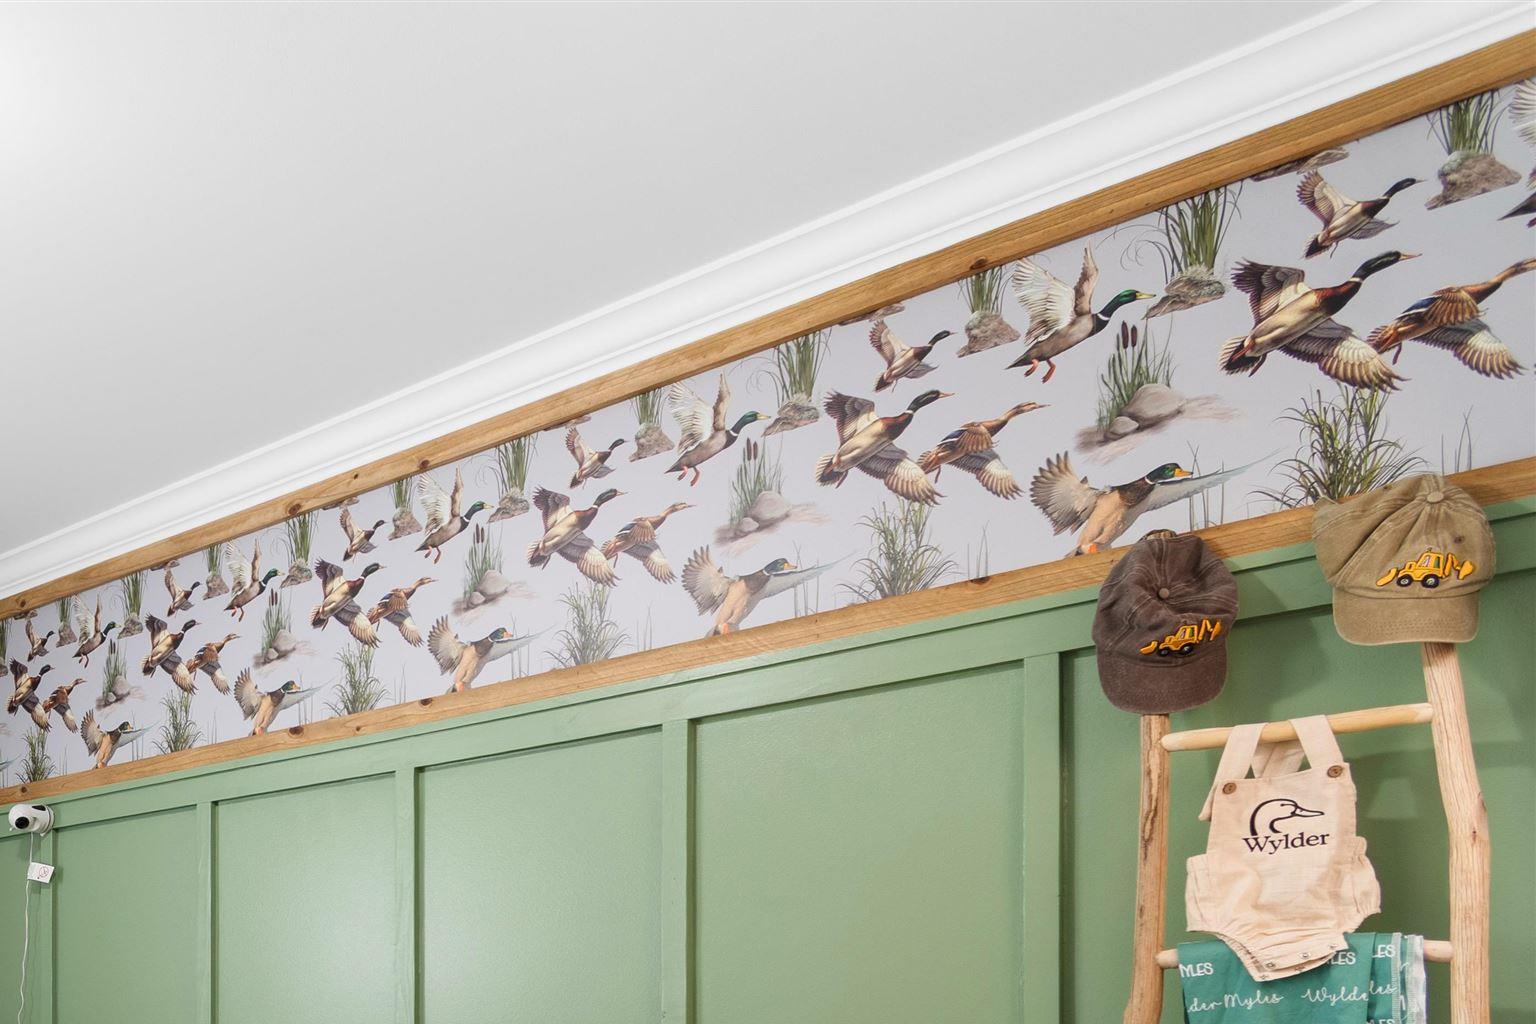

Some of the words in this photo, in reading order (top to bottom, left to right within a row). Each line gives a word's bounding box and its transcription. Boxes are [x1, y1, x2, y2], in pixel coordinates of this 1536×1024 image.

[1242, 831, 1330, 855] Wylder
[1327, 952, 1357, 966] LES
[1223, 990, 1284, 1010] Myles
[1301, 986, 1369, 1007] Wylde
